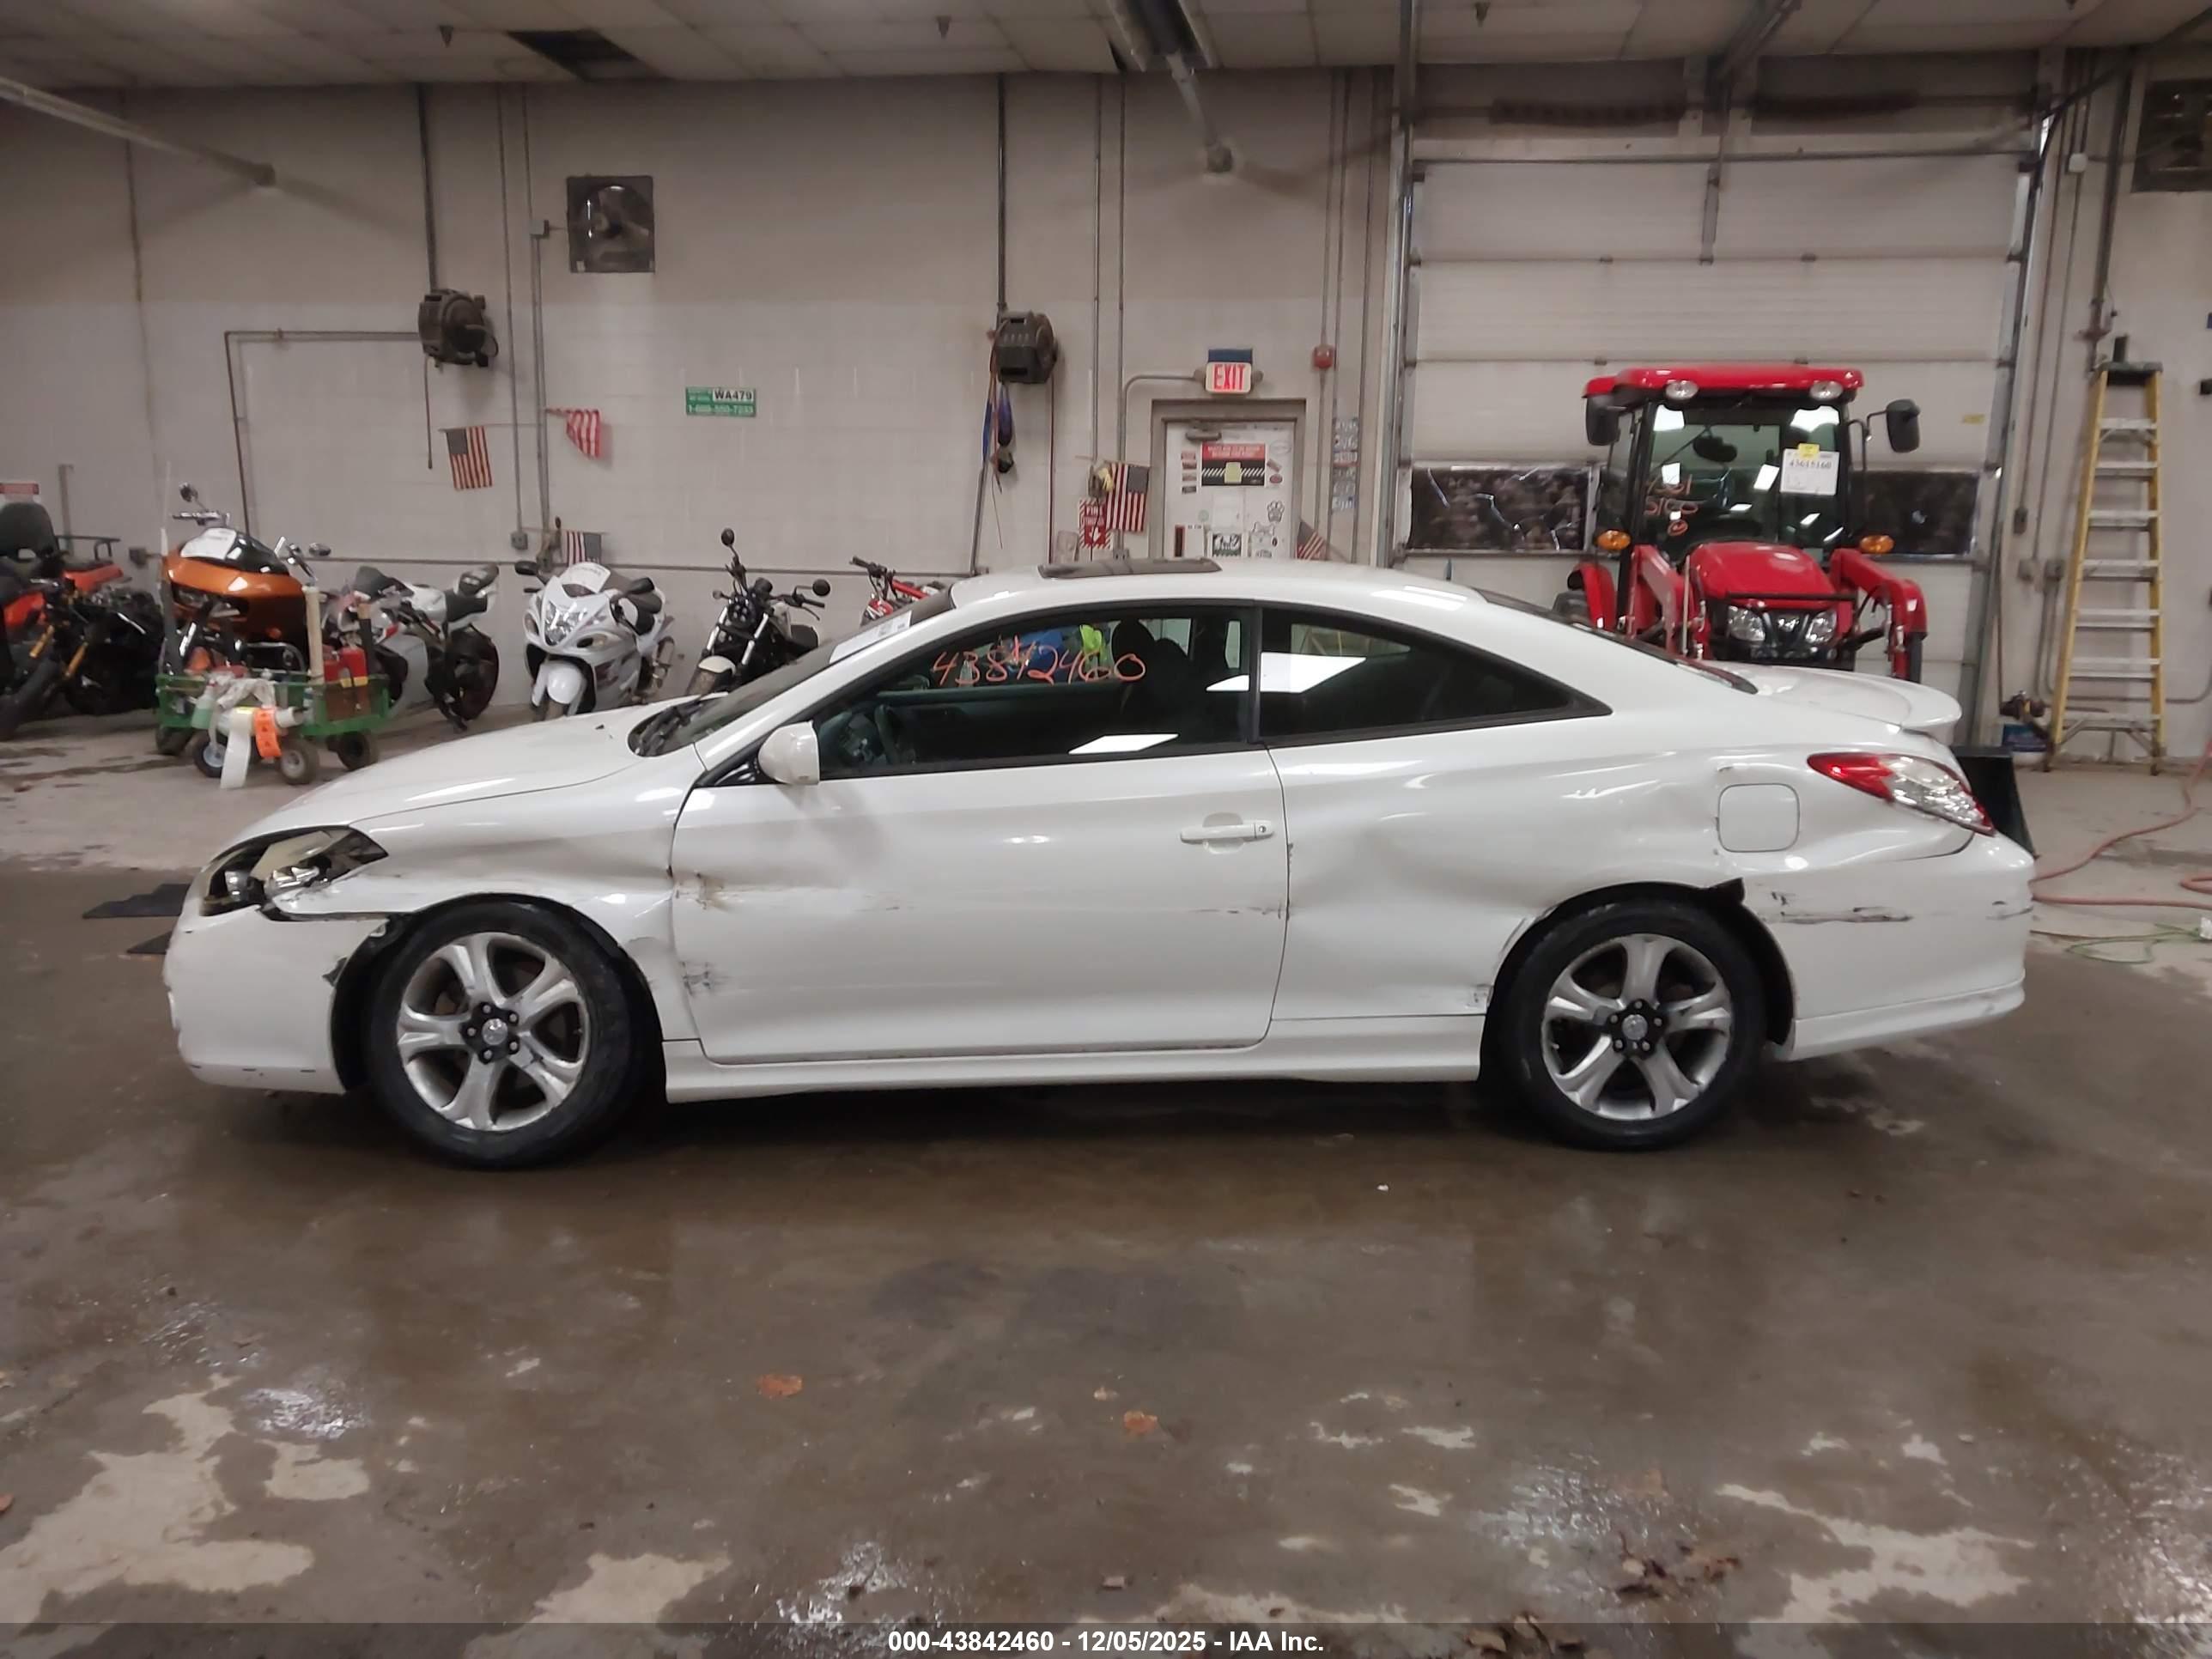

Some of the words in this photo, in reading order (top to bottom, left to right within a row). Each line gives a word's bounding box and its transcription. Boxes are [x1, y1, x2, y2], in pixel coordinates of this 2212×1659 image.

[1213, 363, 1246, 391] EXIT
[714, 389, 752, 400] WA479
[930, 636, 1146, 686] 43842460
